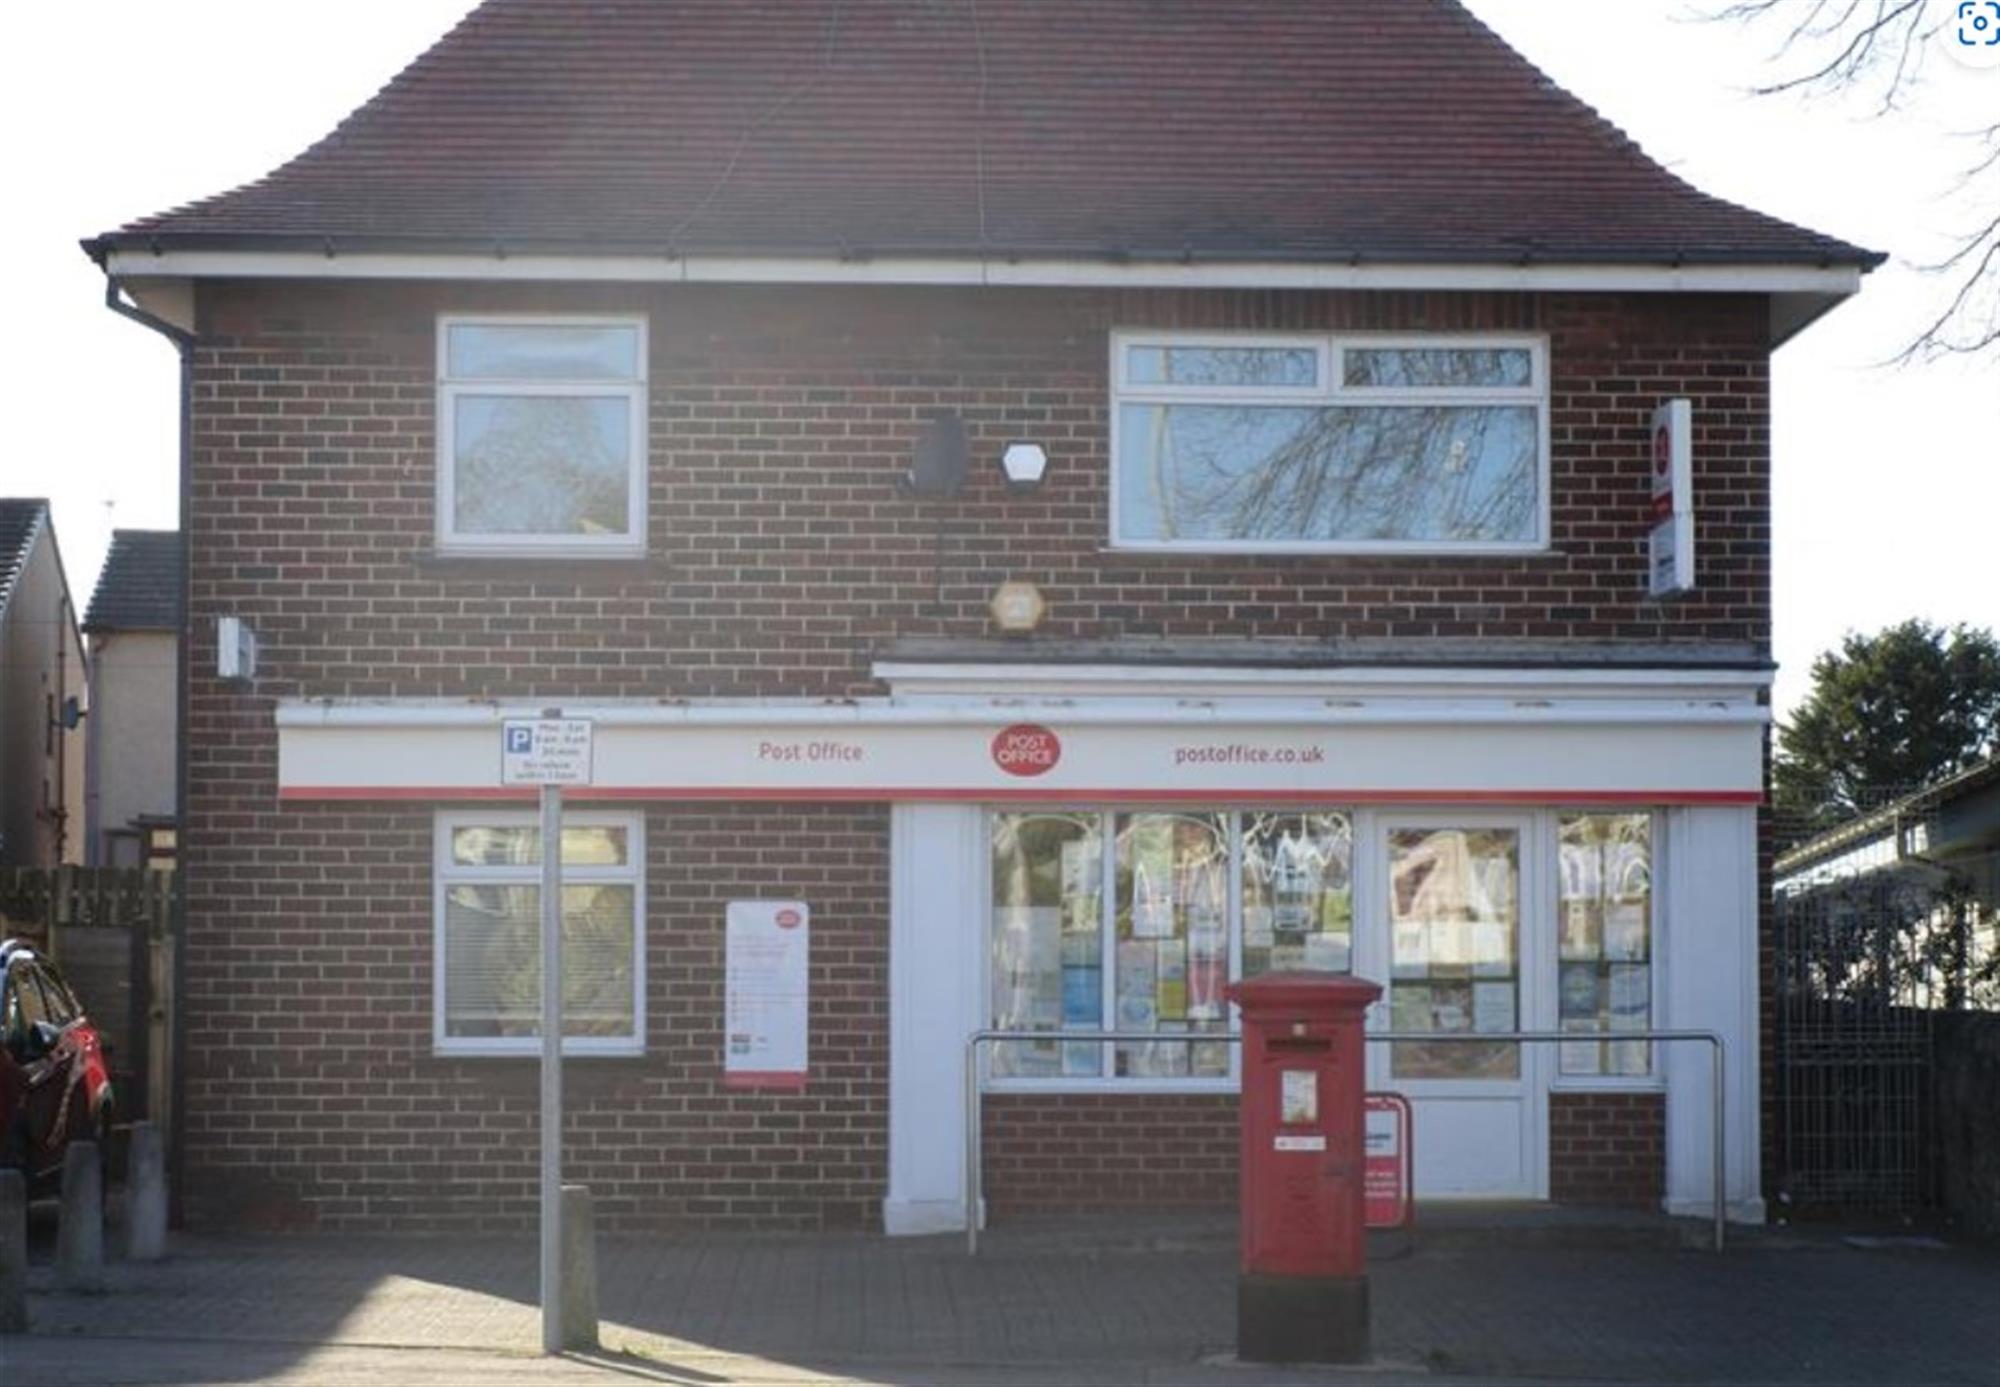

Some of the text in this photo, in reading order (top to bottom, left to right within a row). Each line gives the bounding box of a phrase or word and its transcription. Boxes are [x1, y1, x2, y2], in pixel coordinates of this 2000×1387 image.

[512, 729, 529, 751] P
[1007, 734, 1047, 750] POST
[758, 742, 864, 761] Post Office
[997, 750, 1052, 764] OFFICE
[1175, 743, 1324, 764] postoffice.co.uk
